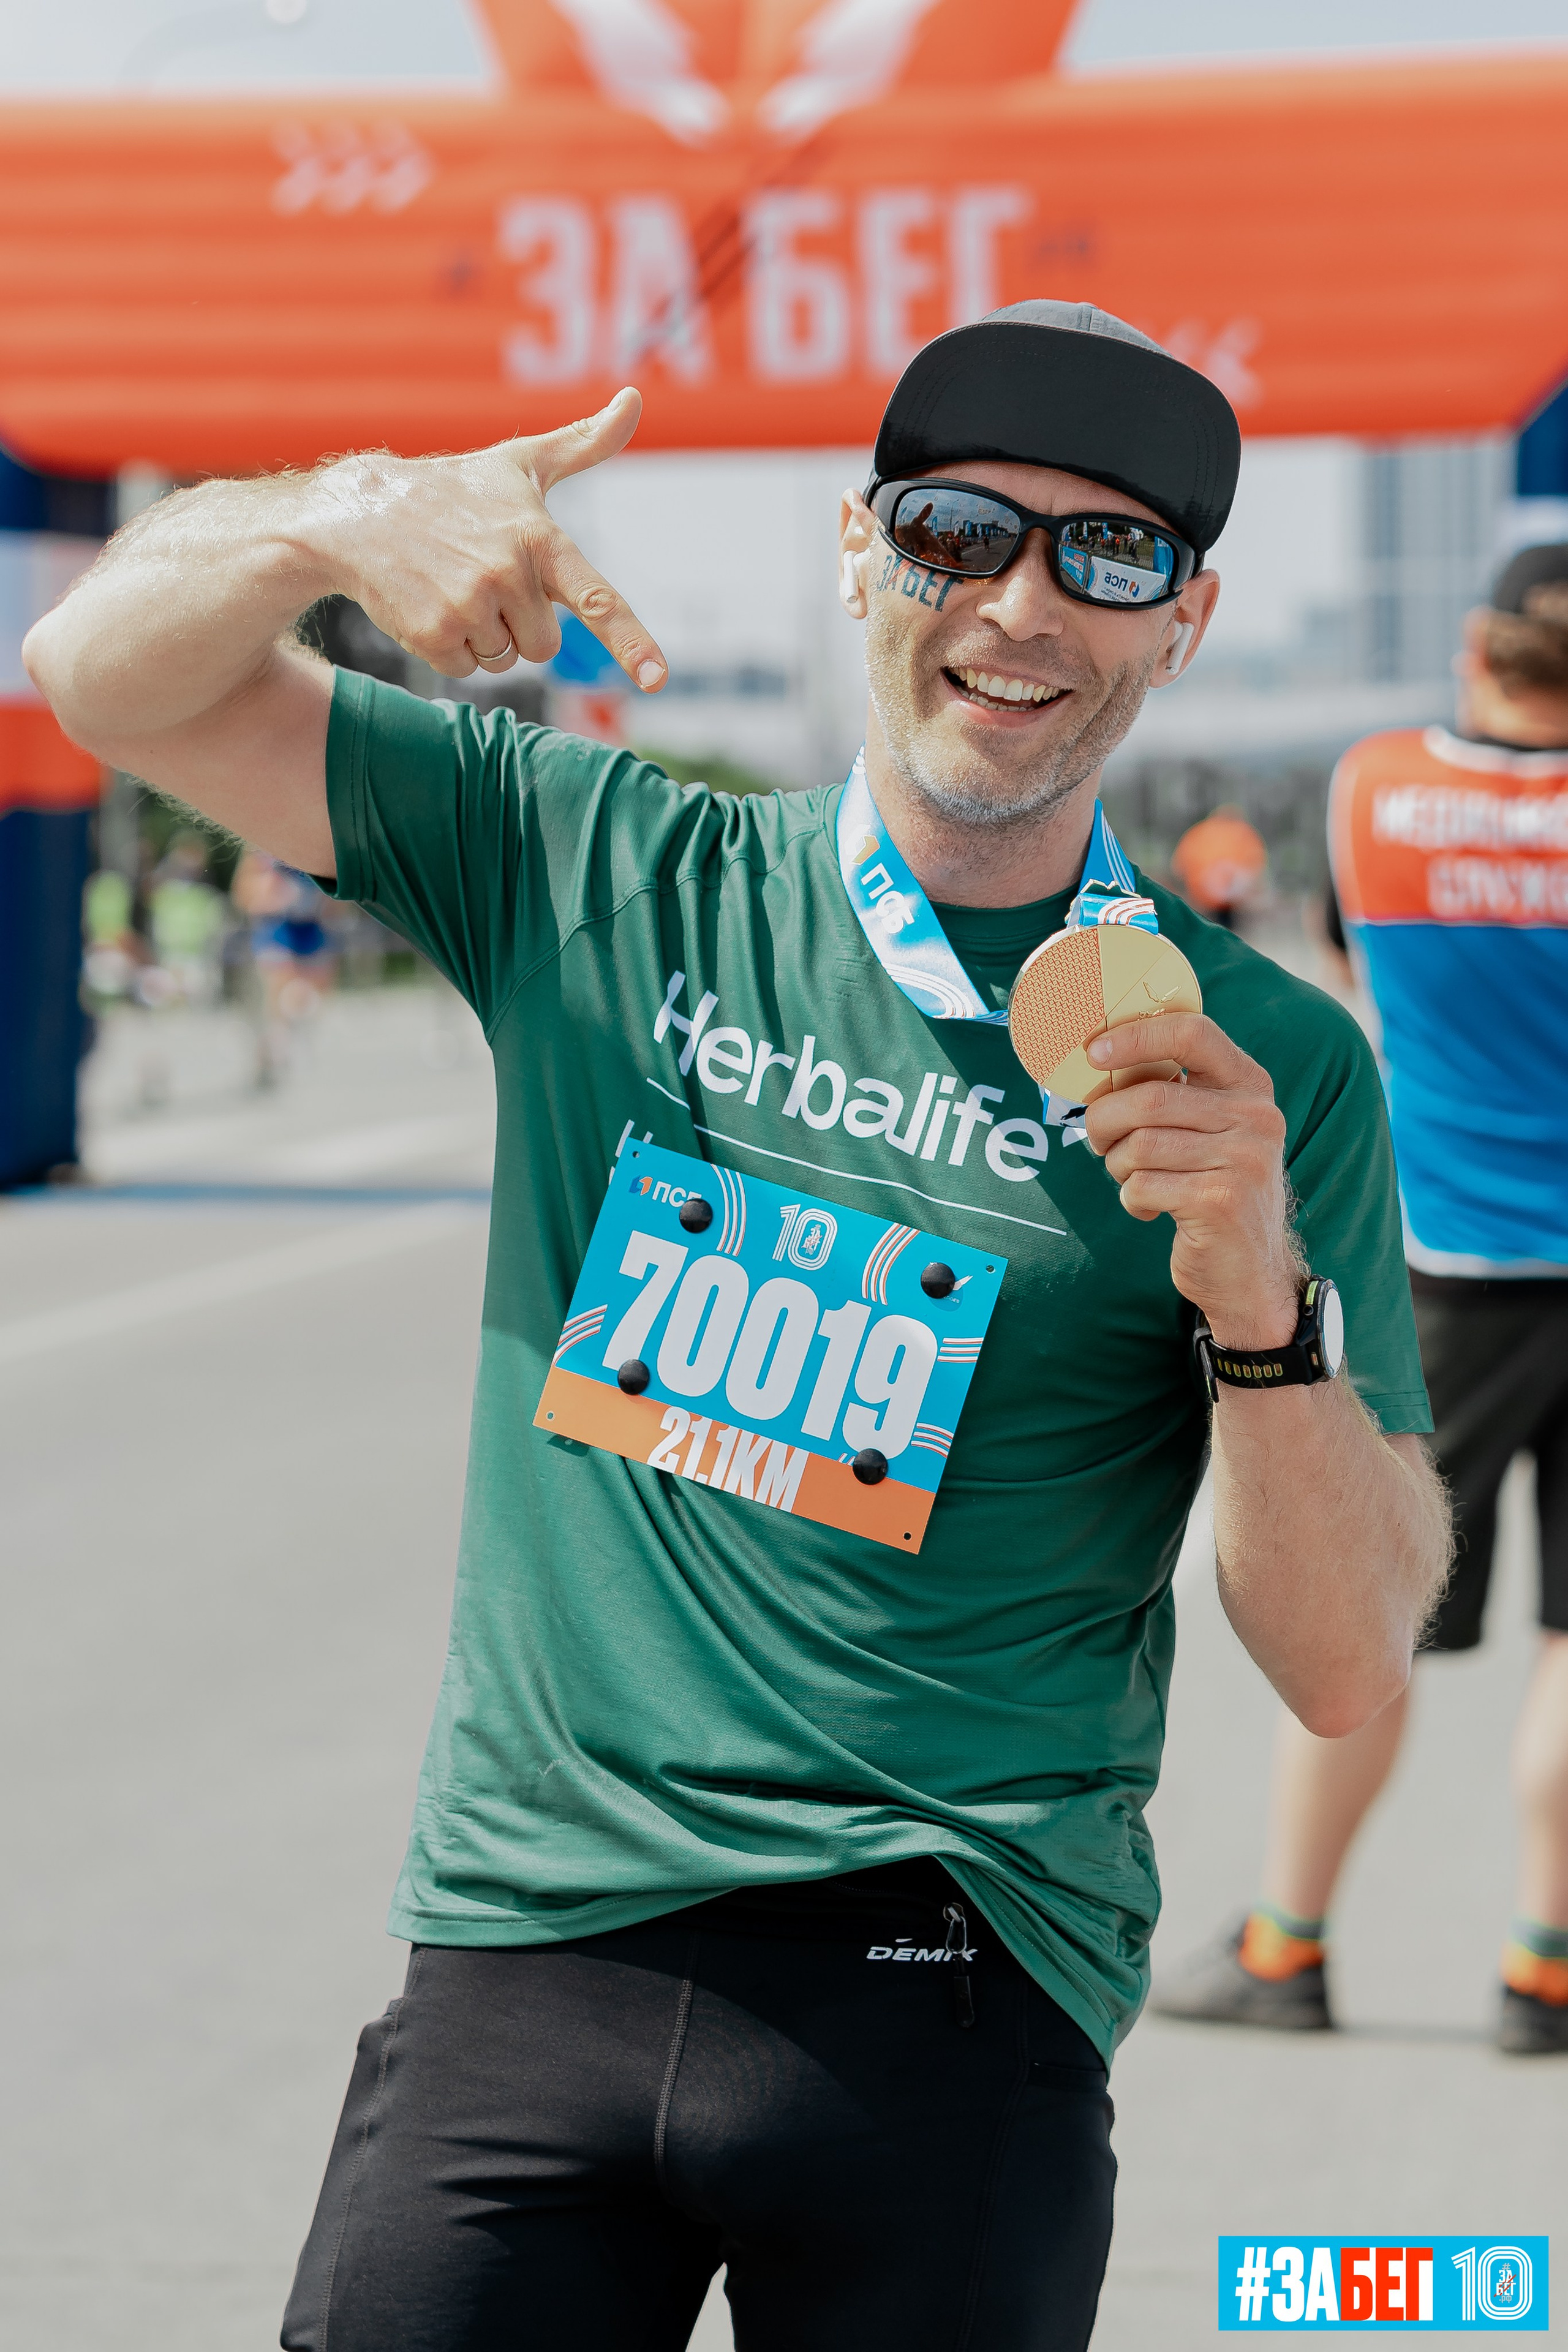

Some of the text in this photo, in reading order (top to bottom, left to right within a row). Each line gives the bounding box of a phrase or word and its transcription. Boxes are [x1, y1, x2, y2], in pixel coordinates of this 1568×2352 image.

[861, 862, 915, 934] ПСБ
[653, 970, 1049, 1182] Herbalife
[772, 1204, 838, 1271] 10
[602, 1230, 938, 1460] 70019
